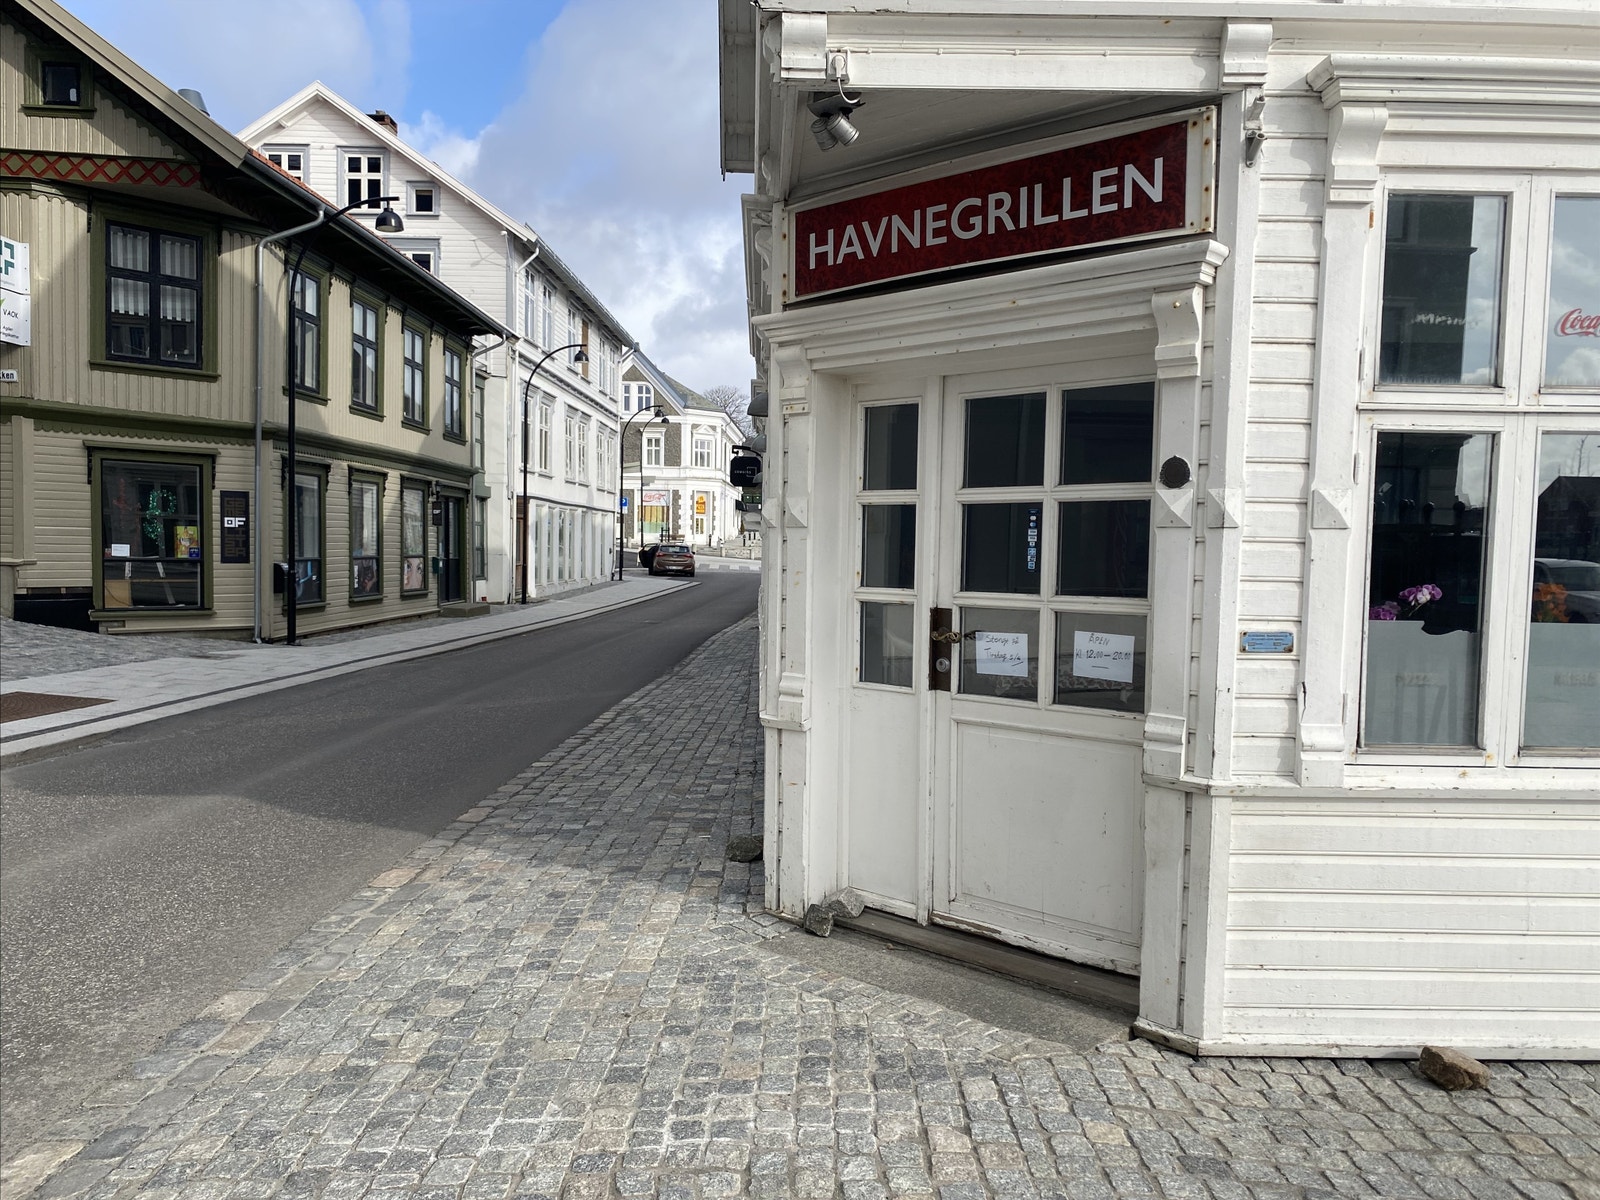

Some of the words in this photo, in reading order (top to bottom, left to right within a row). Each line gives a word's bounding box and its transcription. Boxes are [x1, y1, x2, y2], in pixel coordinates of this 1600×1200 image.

[808, 157, 1164, 270] HAVNEGRILLEN
[0, 371, 15, 380] ken
[224, 517, 246, 528] OF
